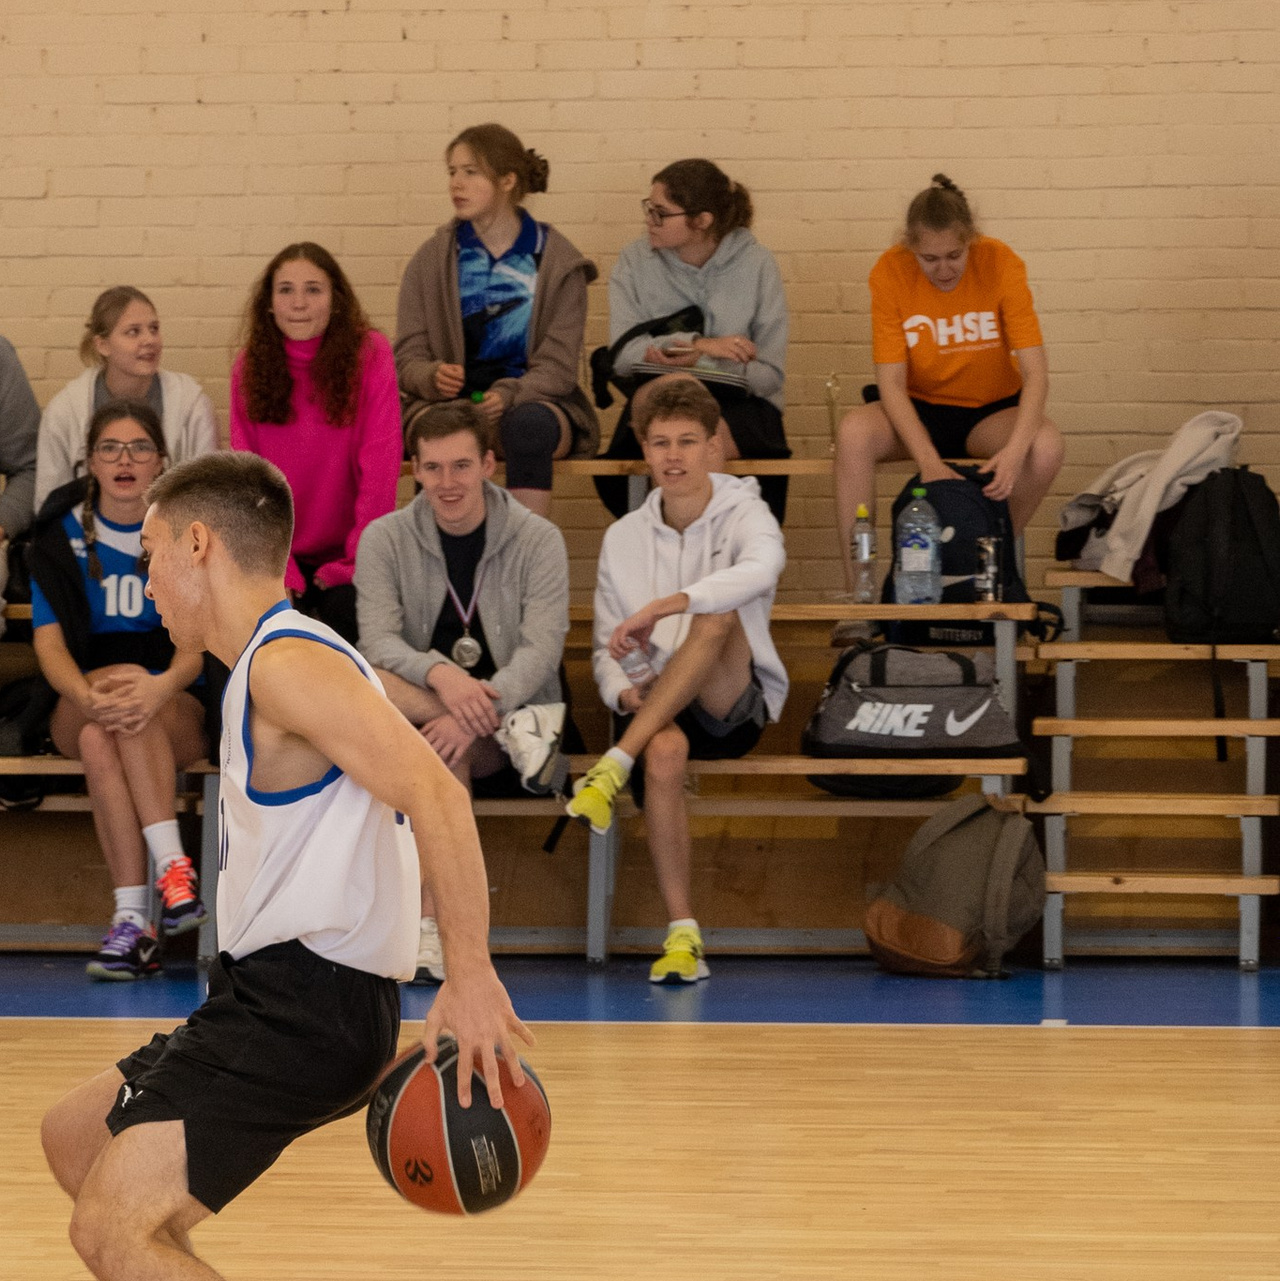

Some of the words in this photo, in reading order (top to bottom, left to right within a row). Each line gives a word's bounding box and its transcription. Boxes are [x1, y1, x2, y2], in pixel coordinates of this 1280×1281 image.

[937, 311, 1000, 346] HSE
[101, 574, 144, 617] 10
[845, 701, 934, 737] NIKE
